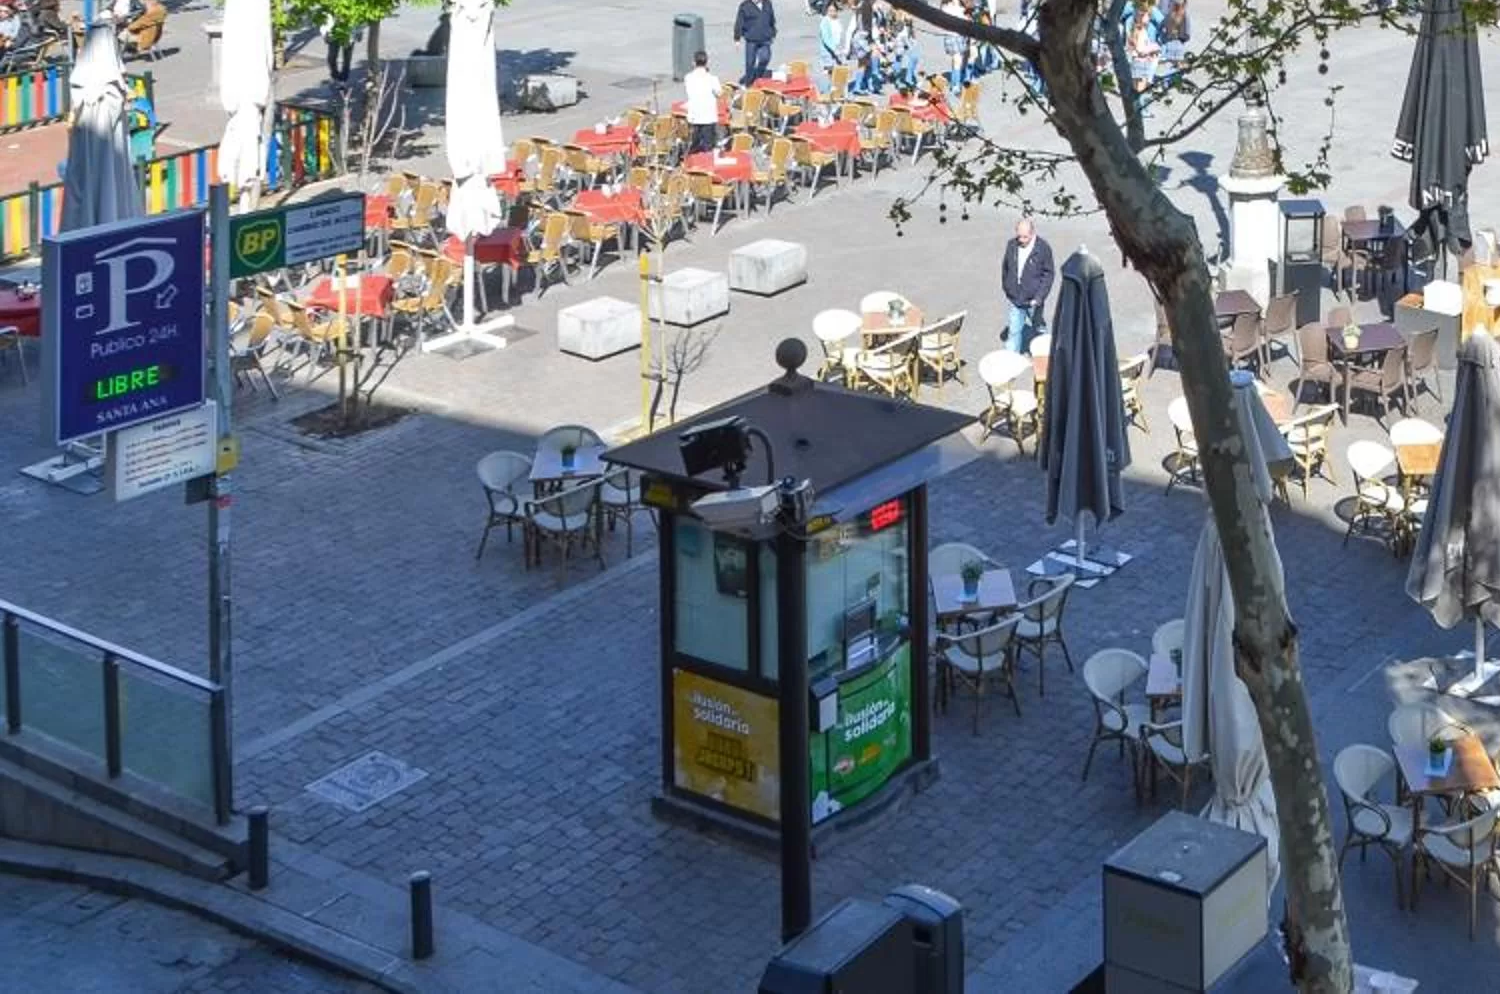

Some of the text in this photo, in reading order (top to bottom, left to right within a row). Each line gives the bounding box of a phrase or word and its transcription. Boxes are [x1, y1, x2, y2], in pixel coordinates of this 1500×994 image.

[243, 229, 276, 255] BP
[95, 249, 175, 336] P
[96, 365, 161, 400] LIBRE
[96, 395, 168, 423] SANTA ANA
